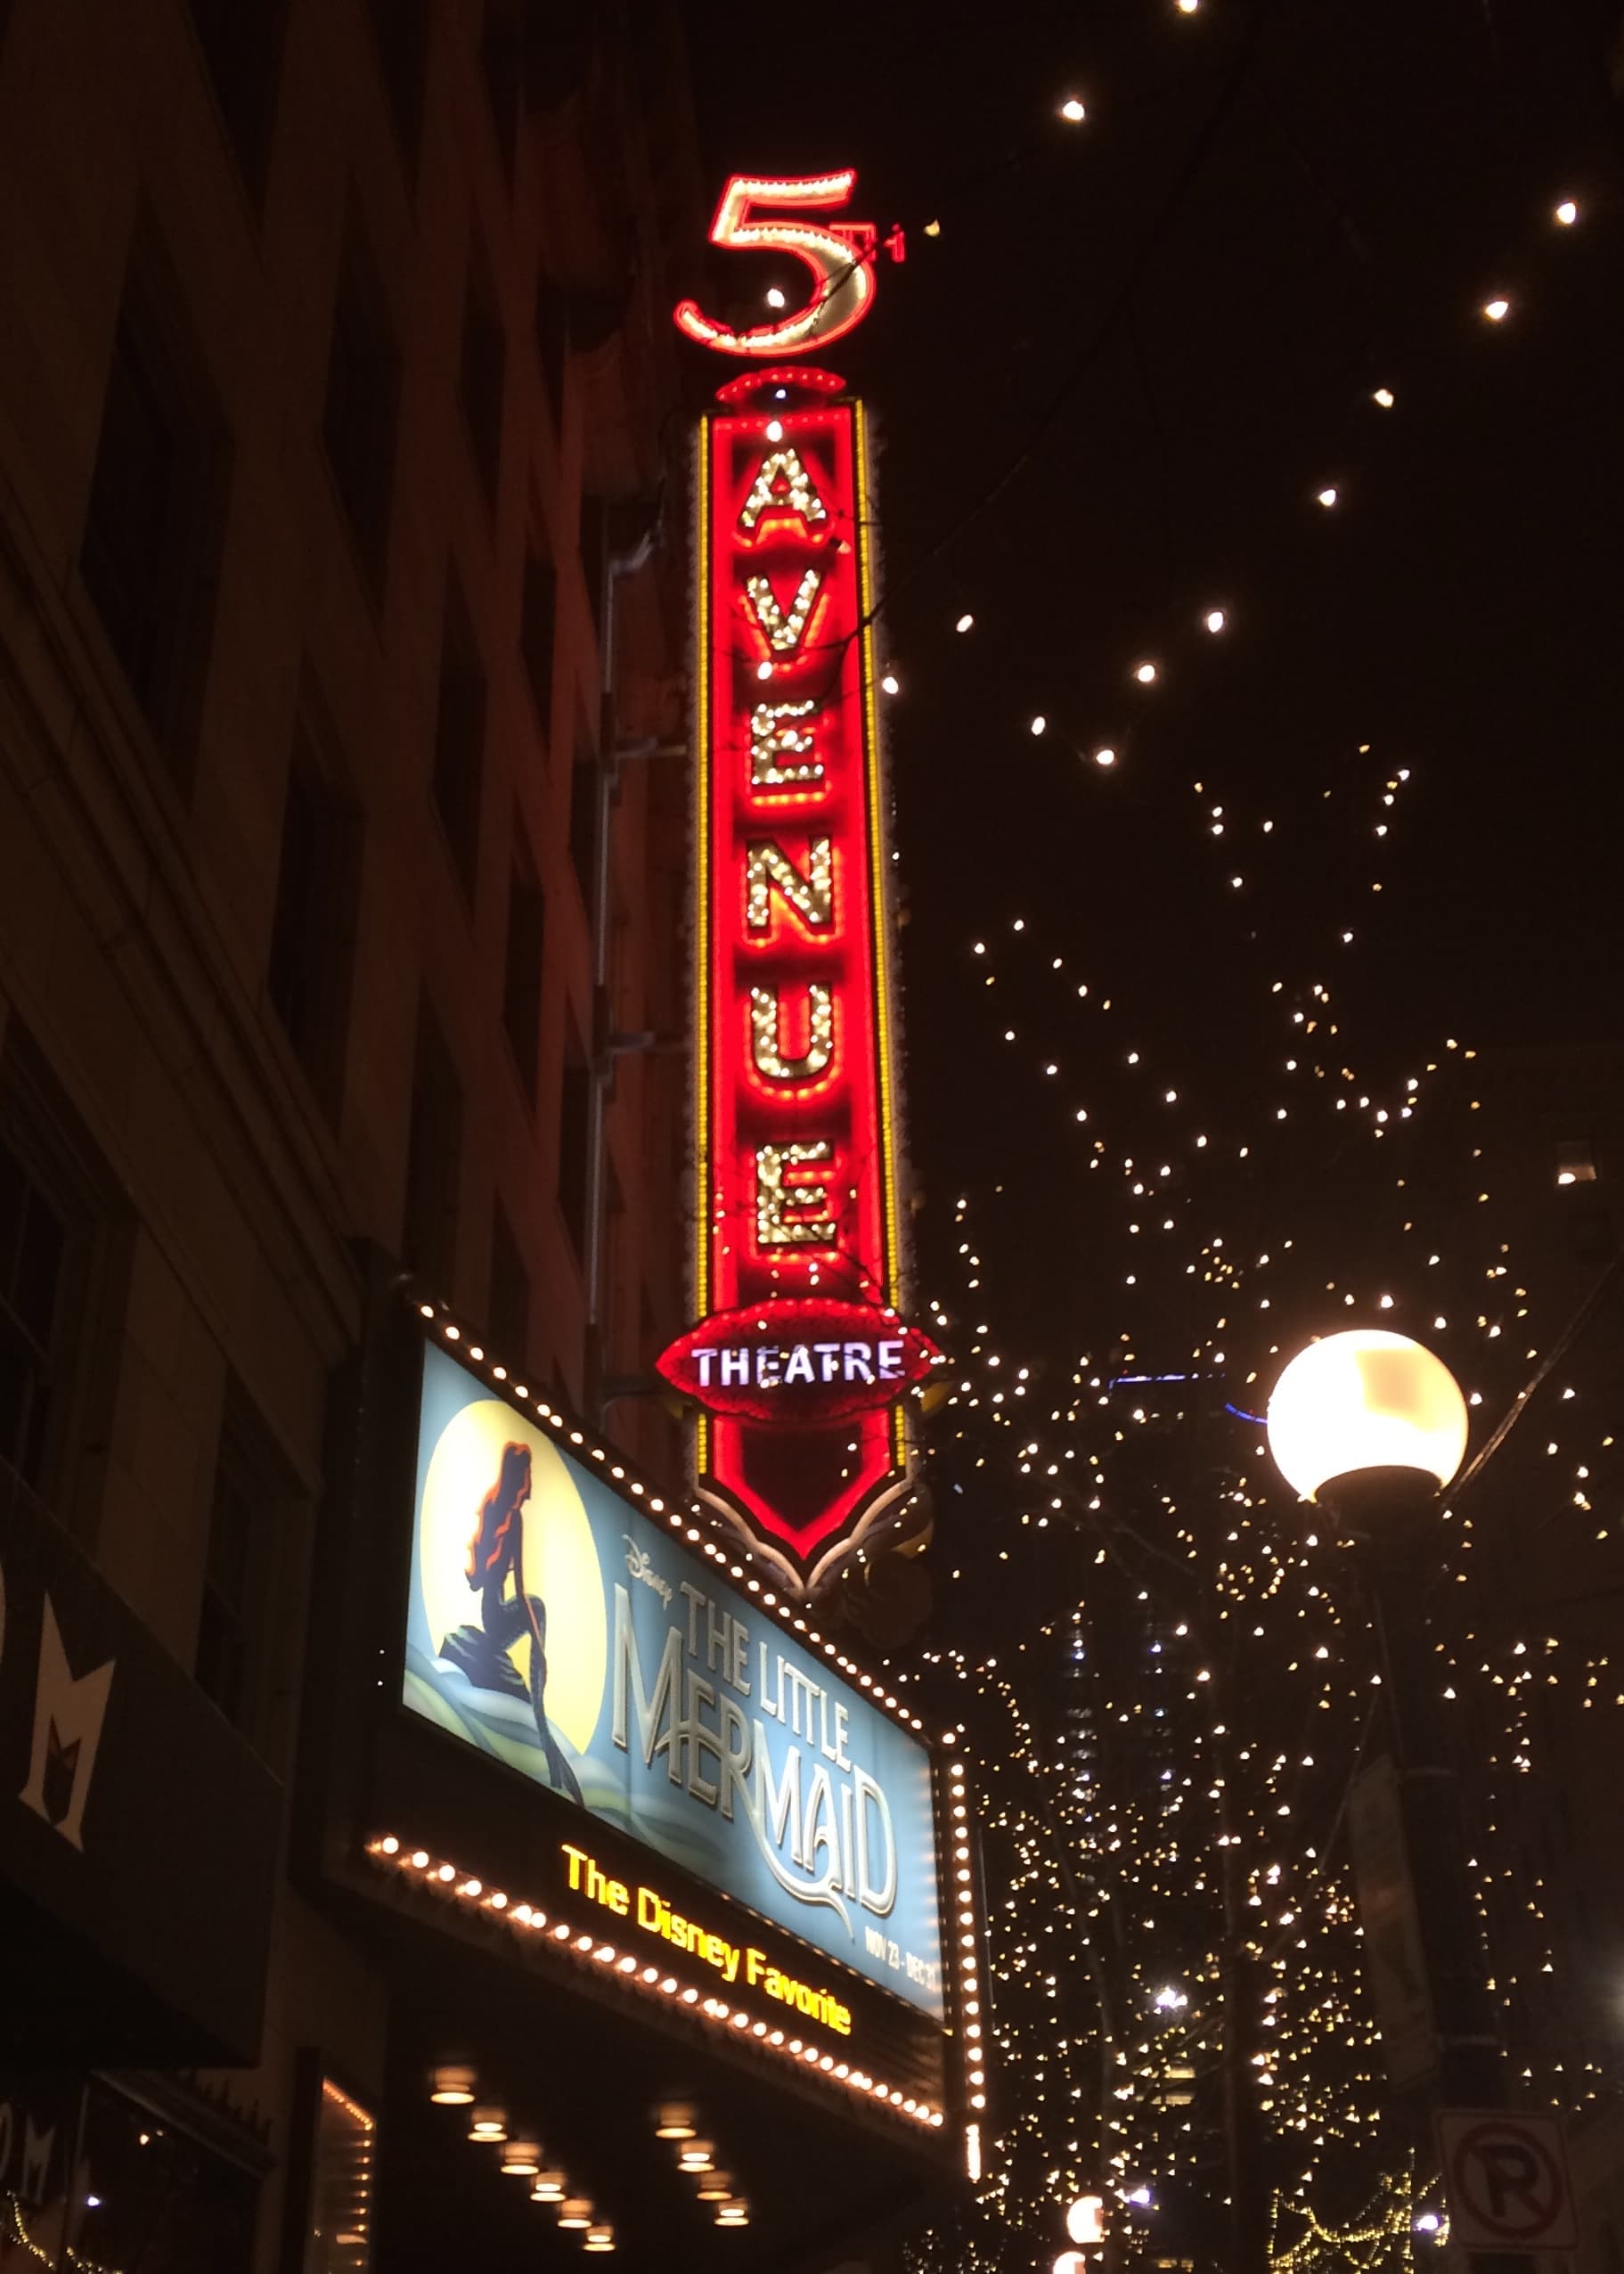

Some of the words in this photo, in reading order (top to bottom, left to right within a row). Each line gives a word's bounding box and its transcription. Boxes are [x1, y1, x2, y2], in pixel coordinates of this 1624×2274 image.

[737, 447, 839, 1247] AVENUE
[691, 1340, 906, 1386] THEATRE
[0, 1558, 116, 1854] M
[611, 1582, 897, 1941] MERMAID
[680, 1581, 752, 1697] THE
[759, 1640, 853, 1775] LITTLE
[561, 1844, 630, 1916] The
[637, 1886, 740, 1984] Disney
[747, 1946, 853, 2036] Favorite
